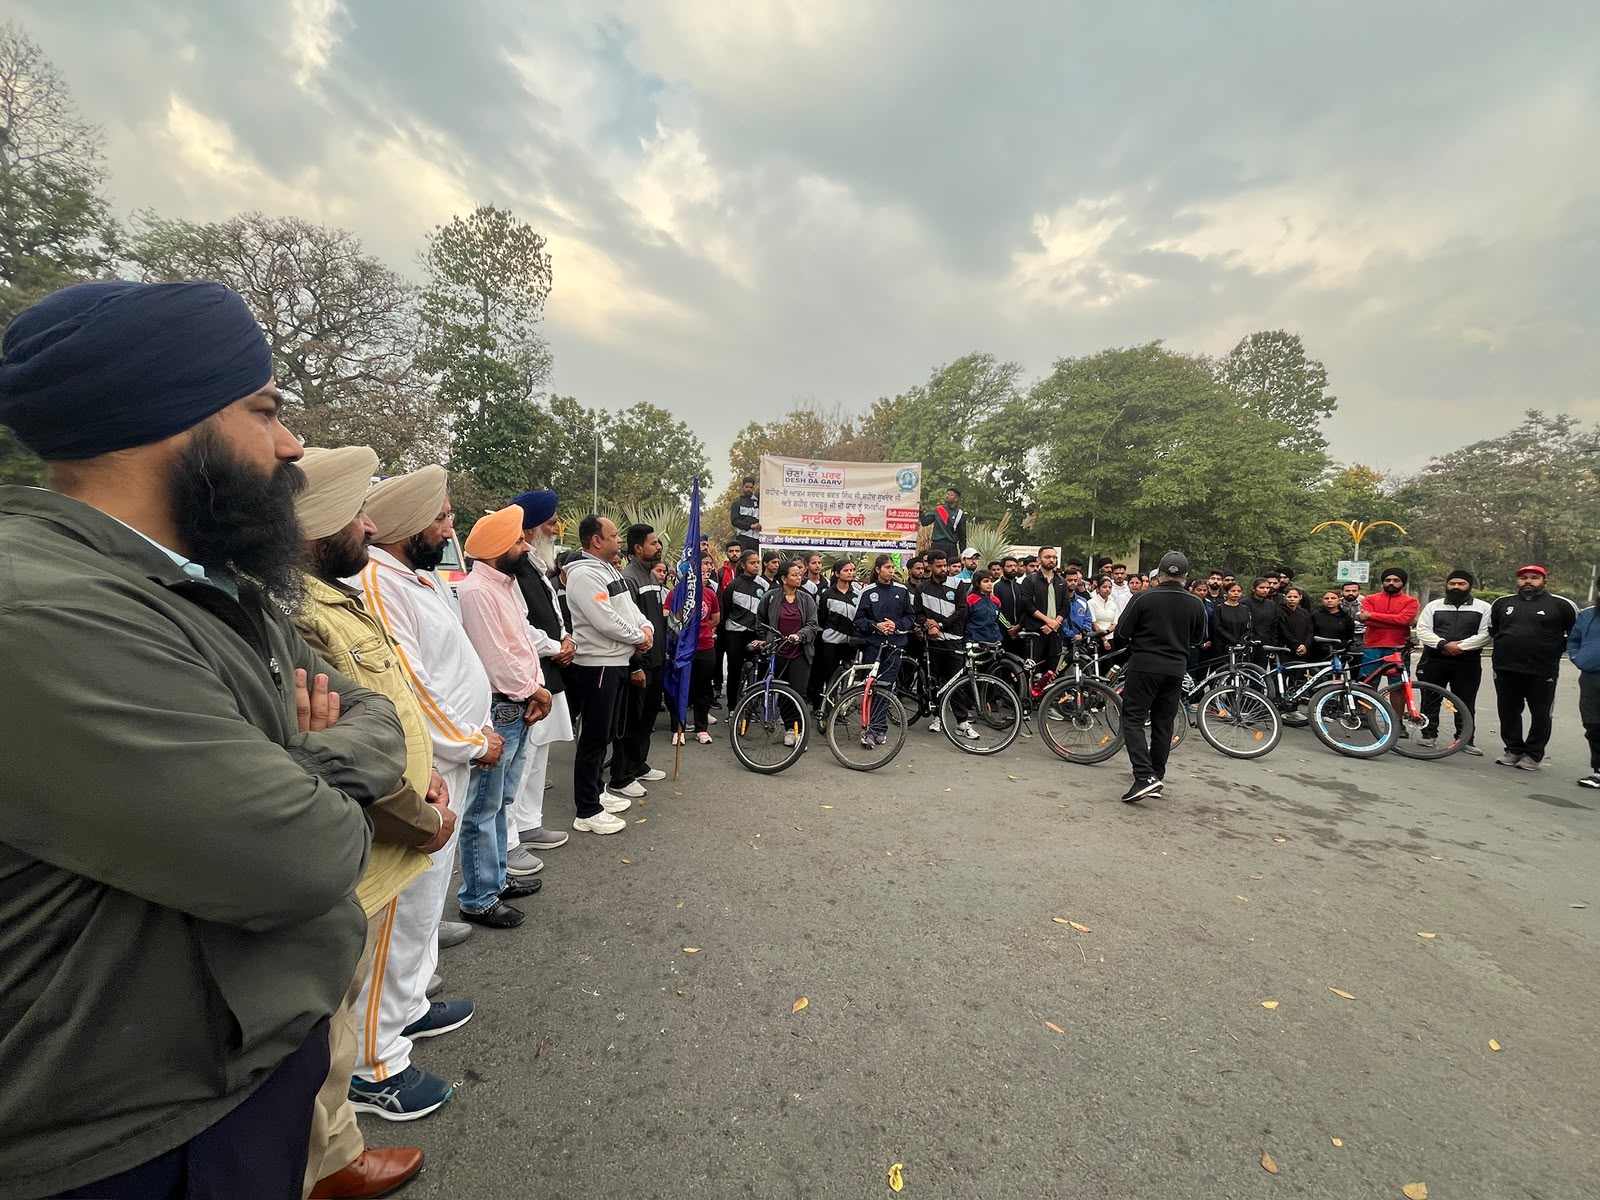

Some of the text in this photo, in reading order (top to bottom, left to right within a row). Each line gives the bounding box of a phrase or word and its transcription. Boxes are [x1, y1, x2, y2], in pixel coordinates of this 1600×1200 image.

[829, 500, 836, 509] ਜੀ
[837, 500, 845, 510] ਦੀ
[845, 502, 856, 510] ਯਾਦ
[801, 511, 842, 525] ਸਾਈਕਲ
